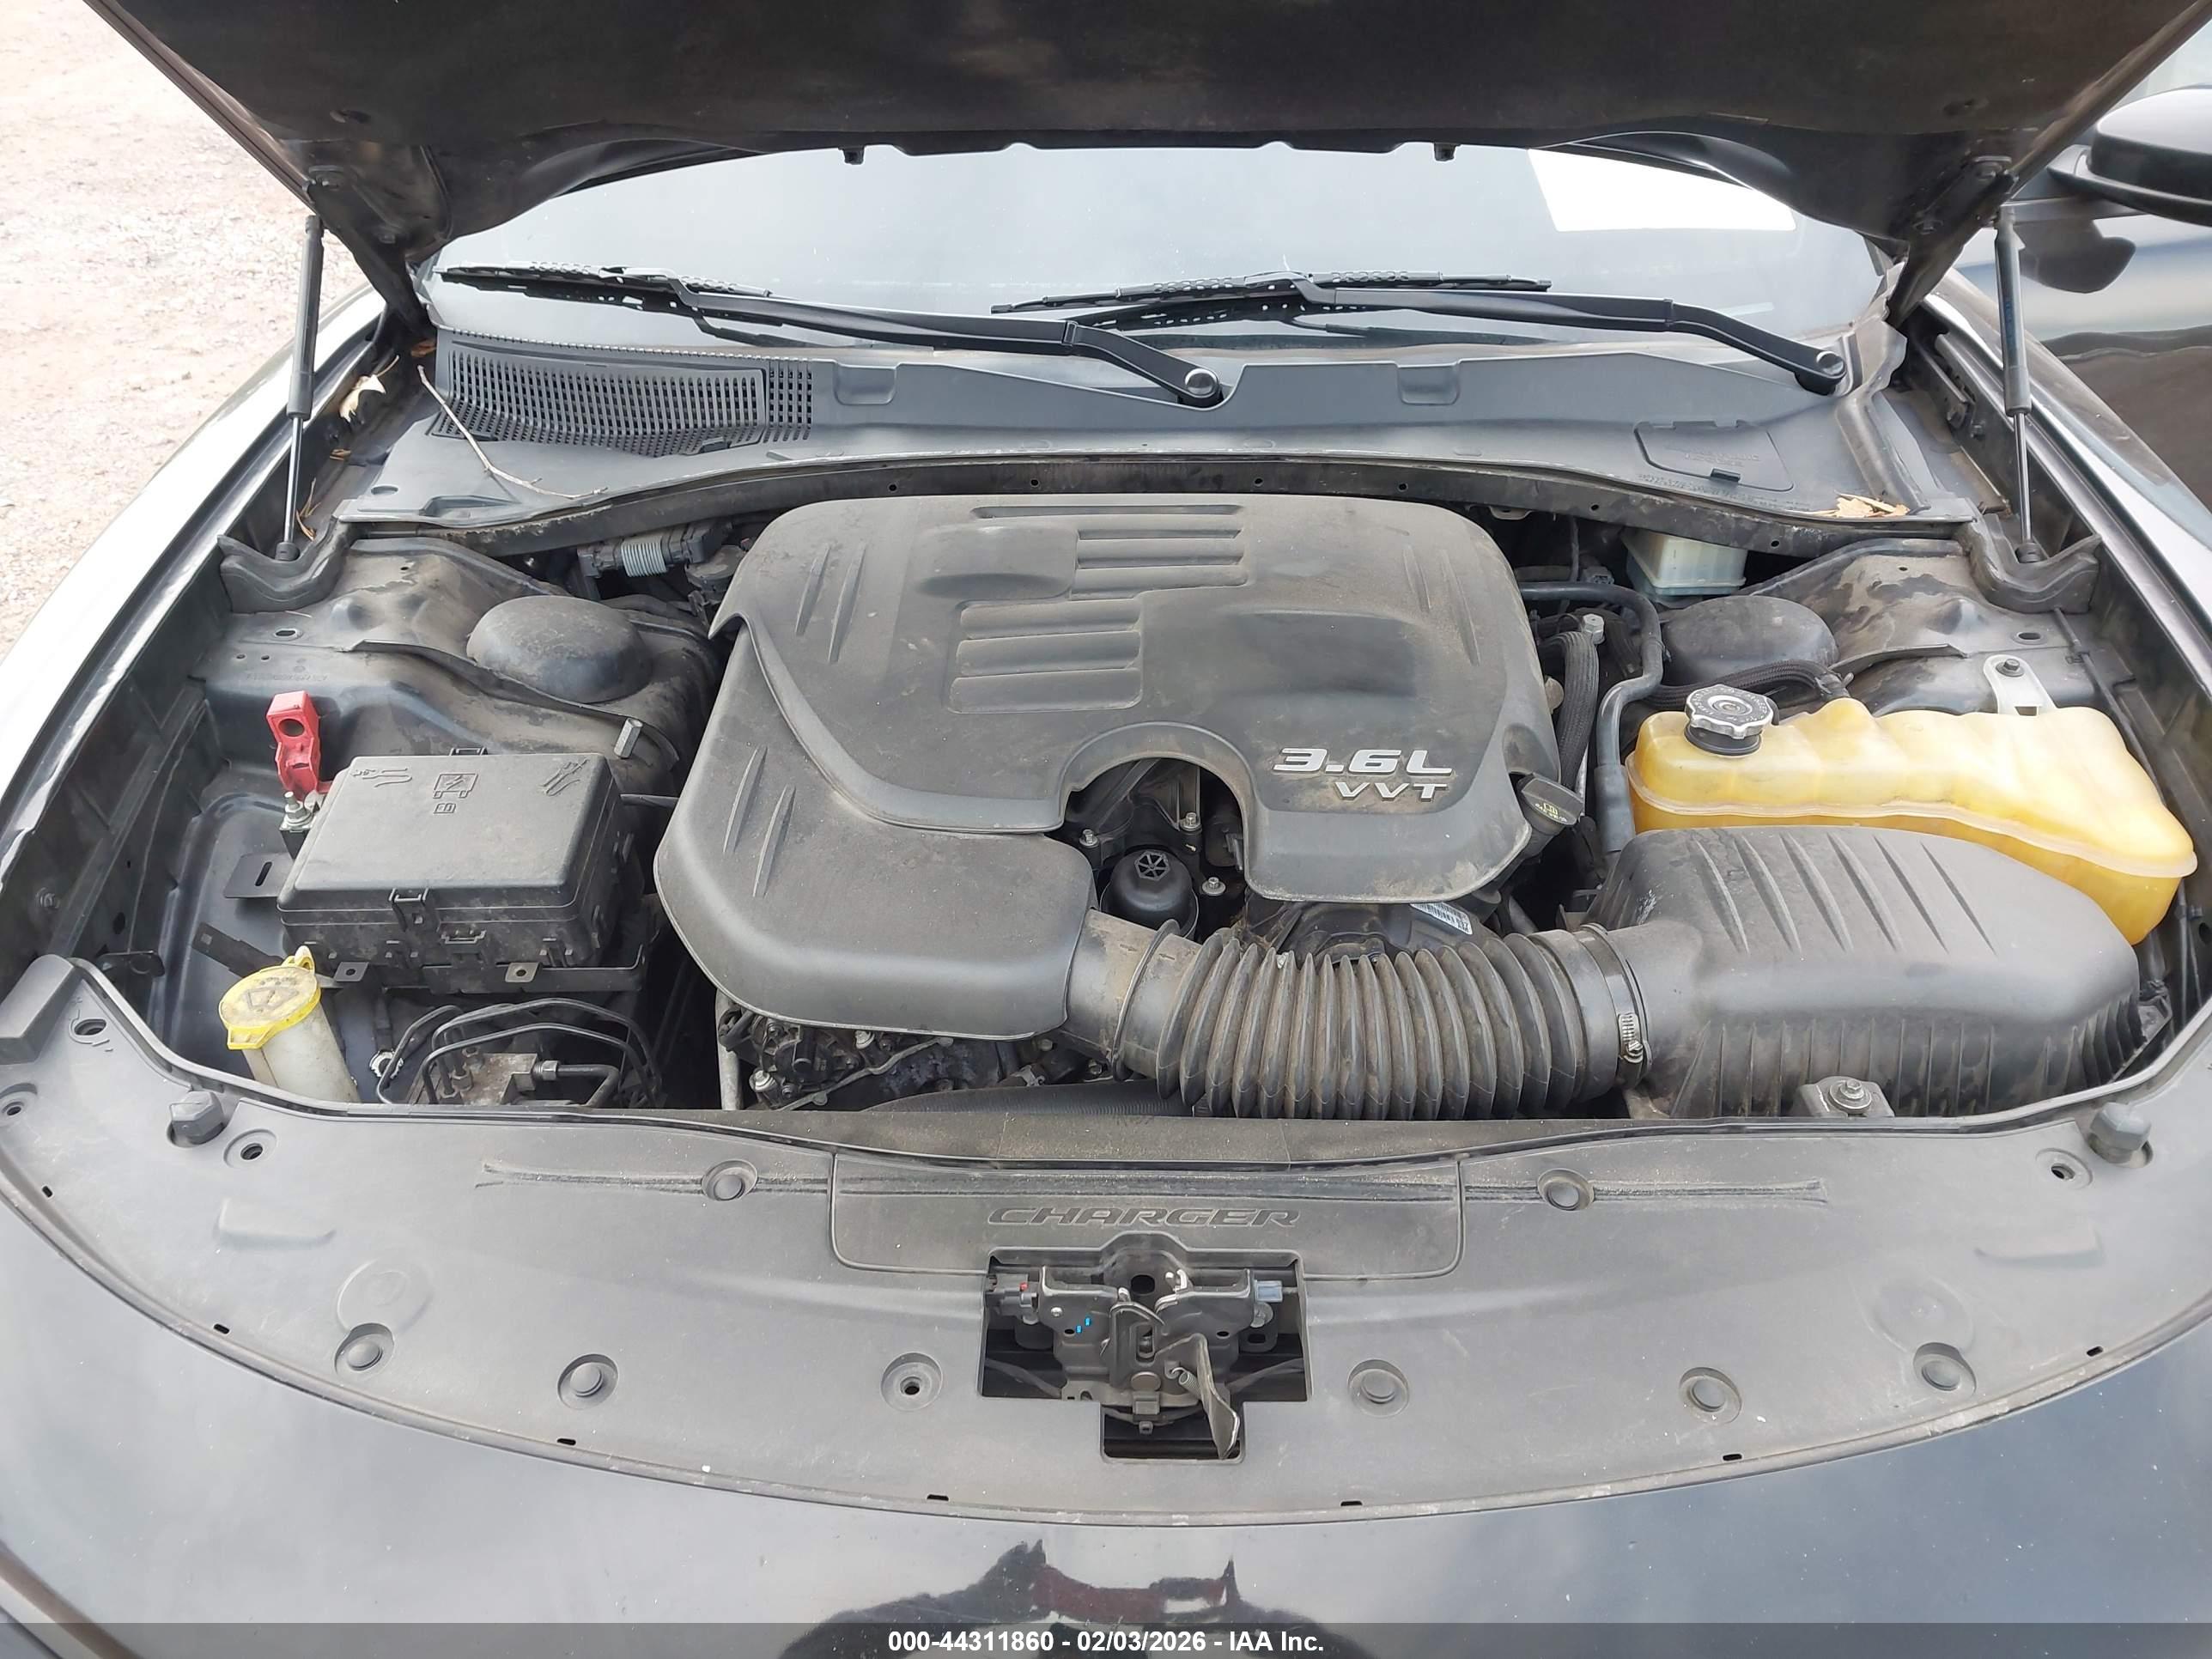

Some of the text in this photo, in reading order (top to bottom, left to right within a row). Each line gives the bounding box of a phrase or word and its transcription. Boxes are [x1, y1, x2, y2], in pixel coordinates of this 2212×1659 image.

[1273, 747, 1453, 776] 3.6L
[1334, 781, 1448, 803] VVT
[988, 1206, 1300, 1228] CHARGER
